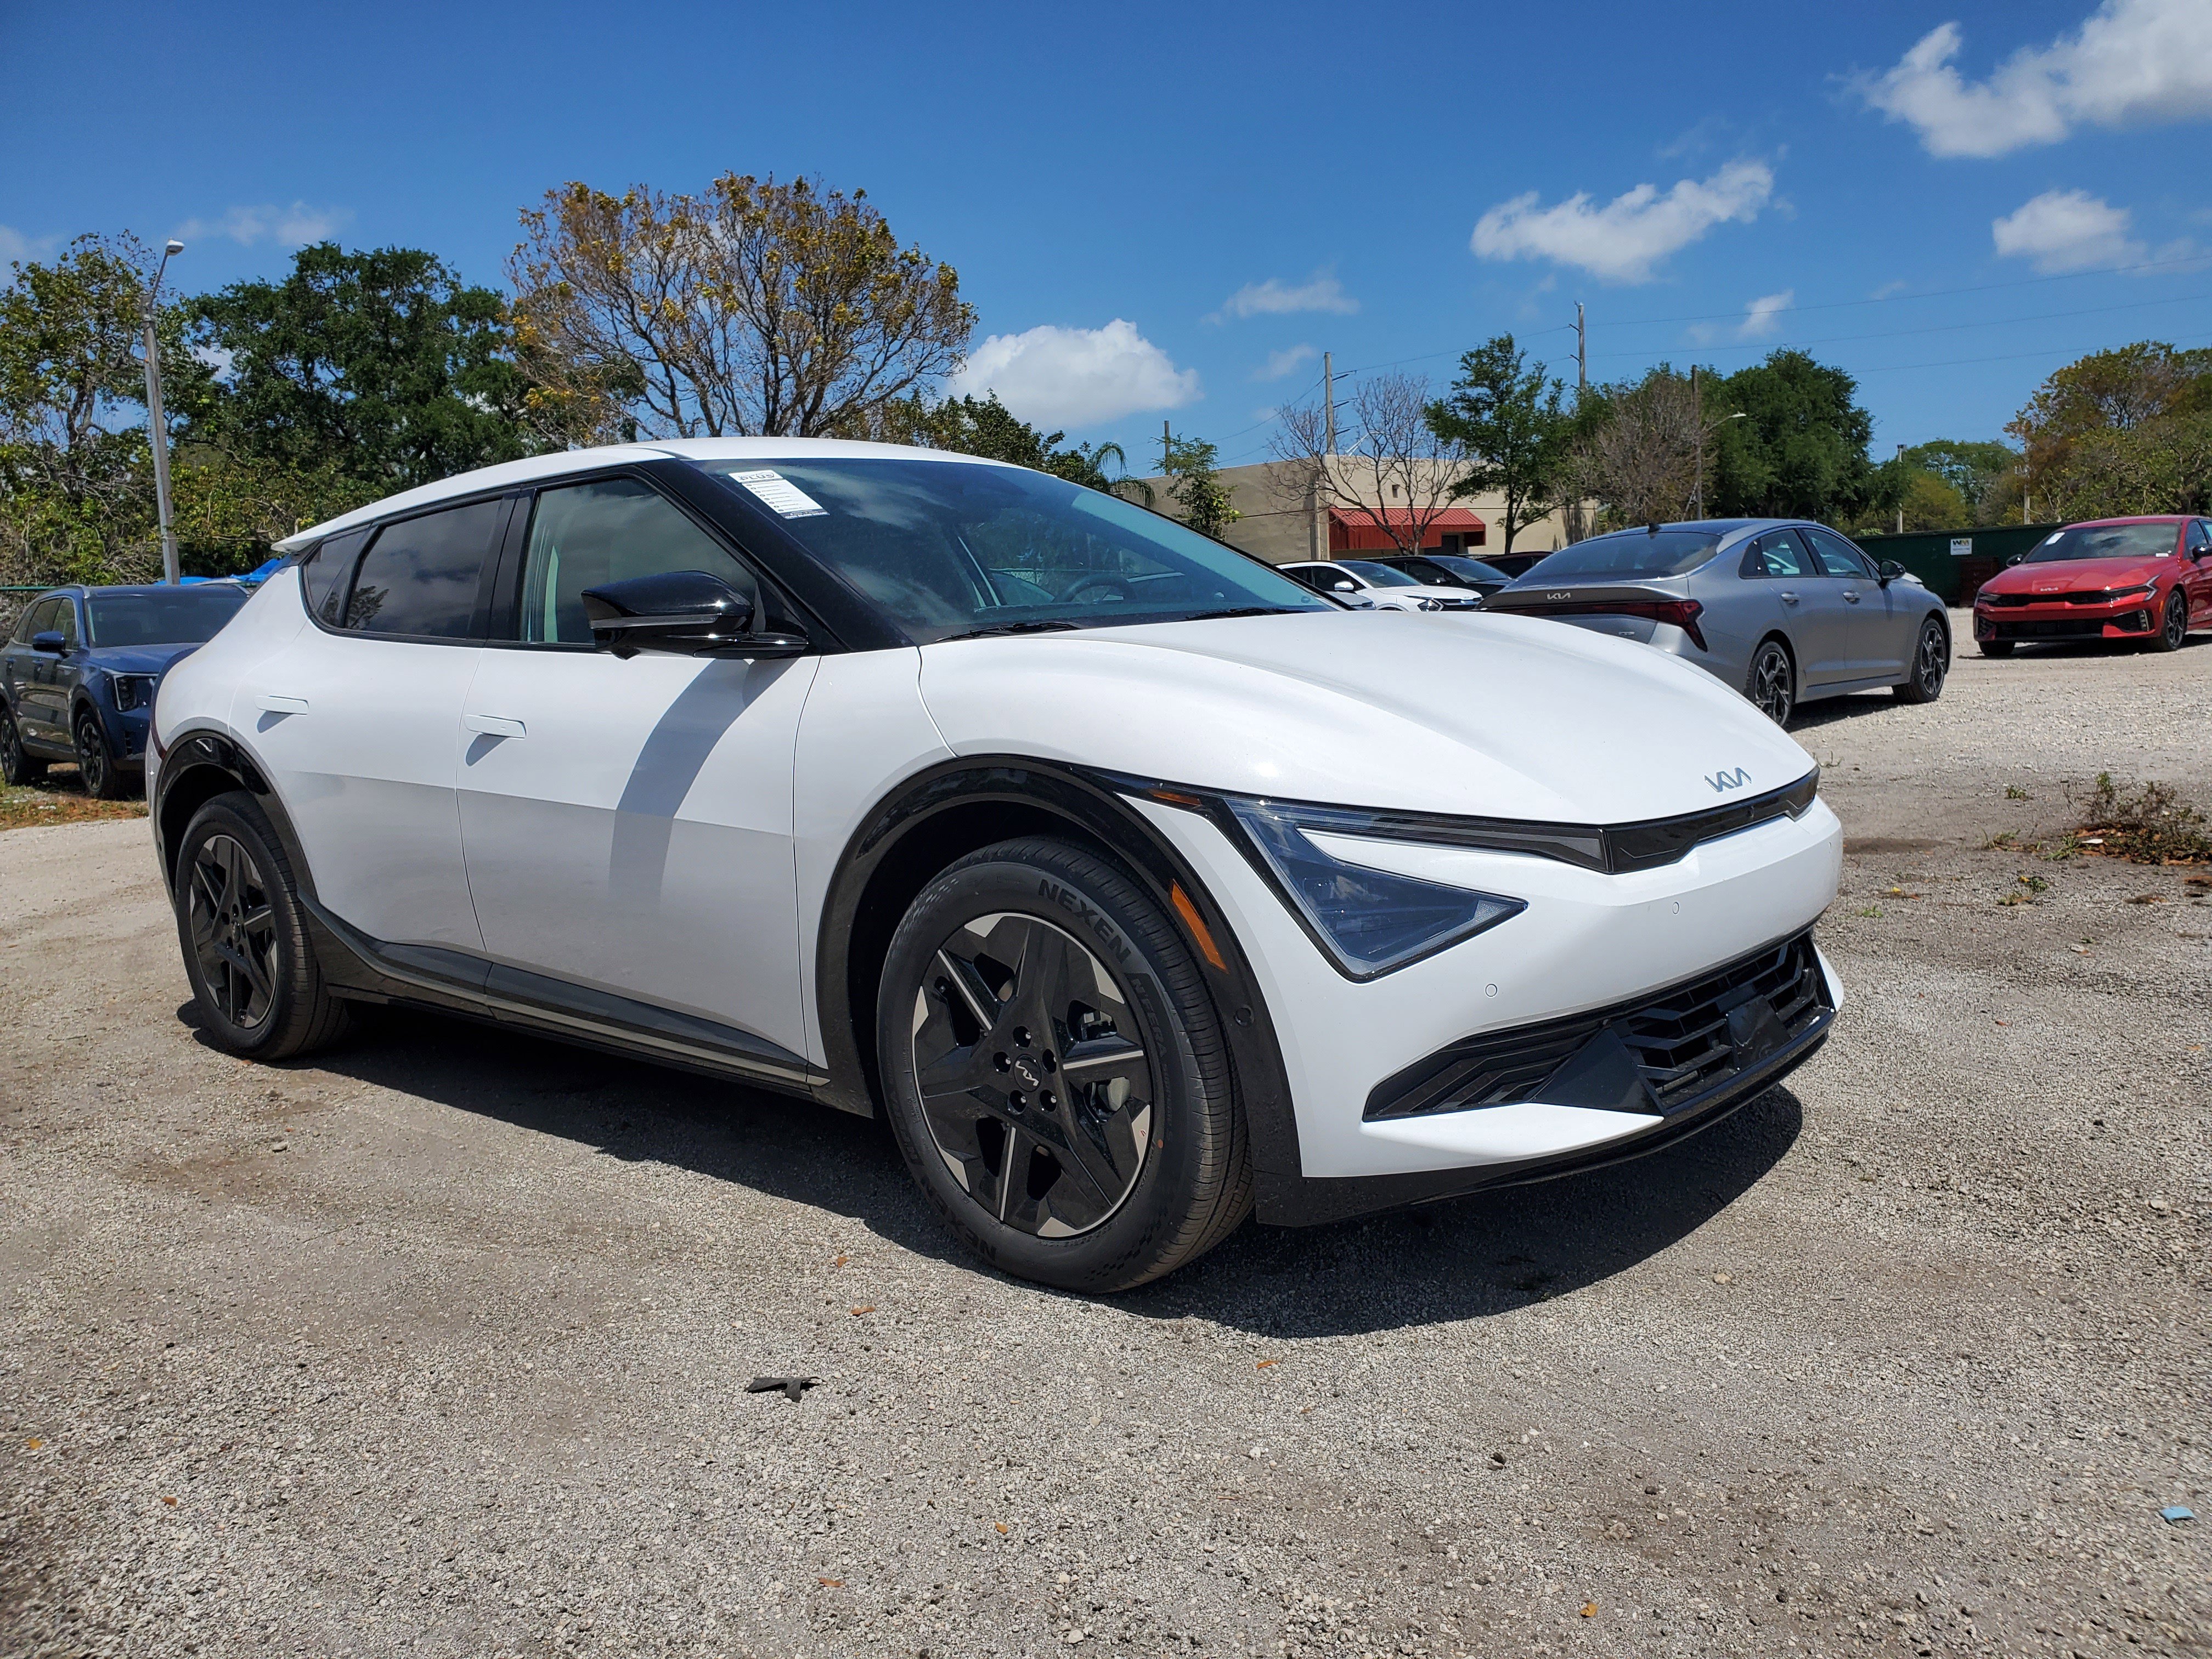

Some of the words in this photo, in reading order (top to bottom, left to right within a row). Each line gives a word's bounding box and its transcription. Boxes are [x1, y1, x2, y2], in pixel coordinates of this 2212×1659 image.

[1704, 767, 1752, 792] KIA
[1039, 879, 1131, 963] NEXEN
[1015, 1060, 1039, 1086] KIA
